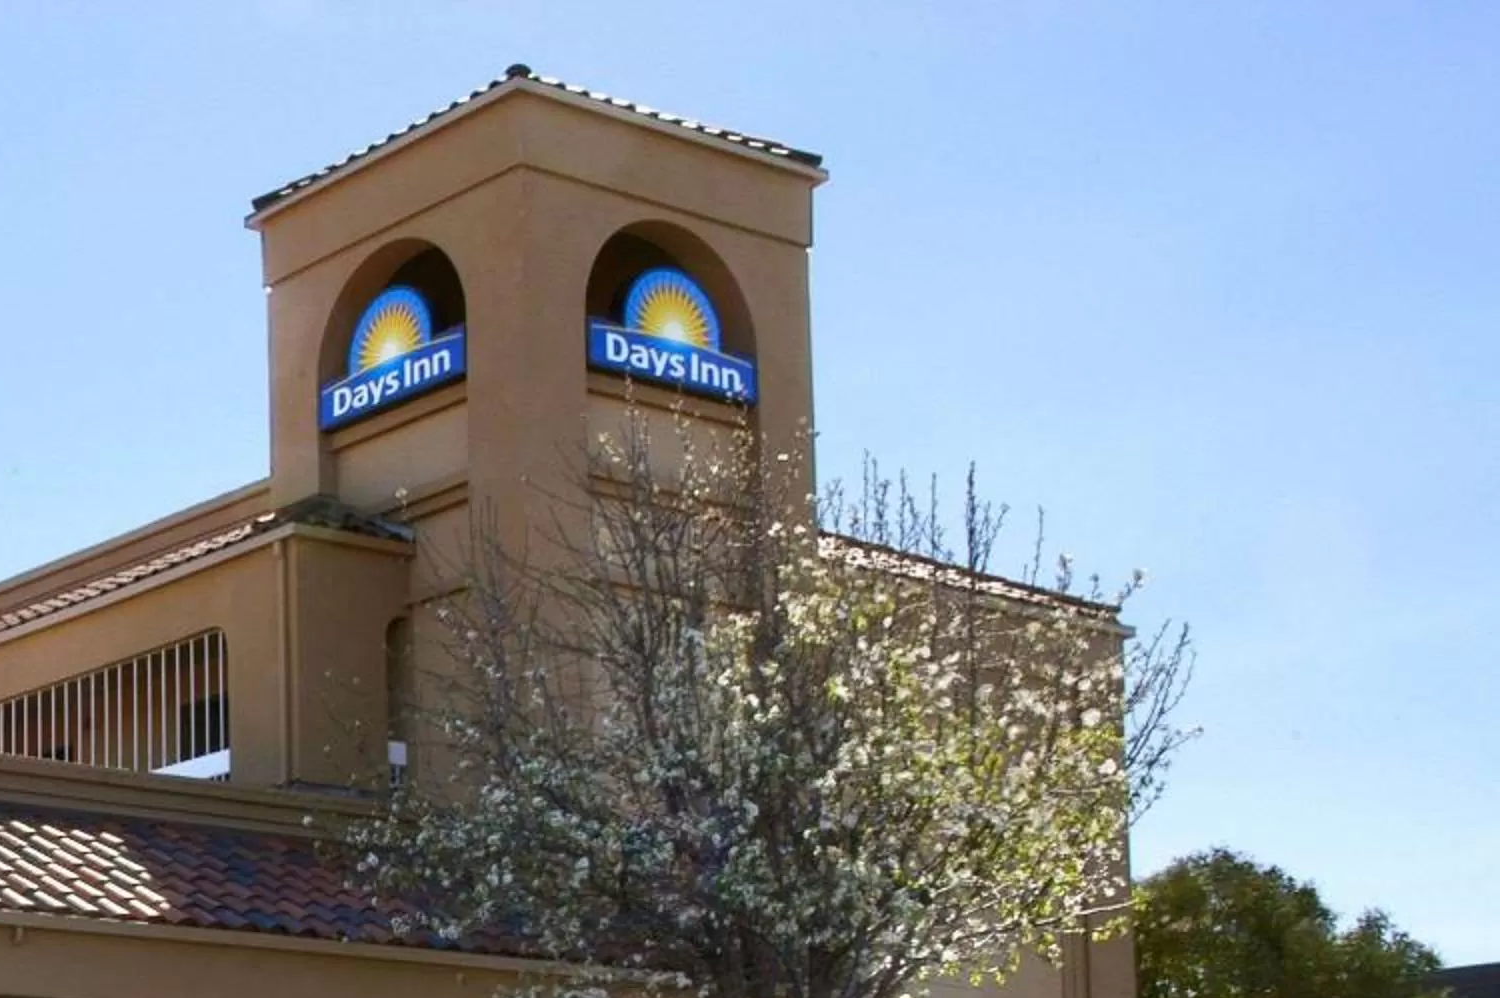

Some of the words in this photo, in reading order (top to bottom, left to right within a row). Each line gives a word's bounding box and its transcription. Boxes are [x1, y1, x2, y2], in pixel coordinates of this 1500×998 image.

[333, 369, 400, 417] Days
[404, 349, 451, 388] Inn
[606, 332, 686, 377] Days
[691, 352, 743, 392] Inn
